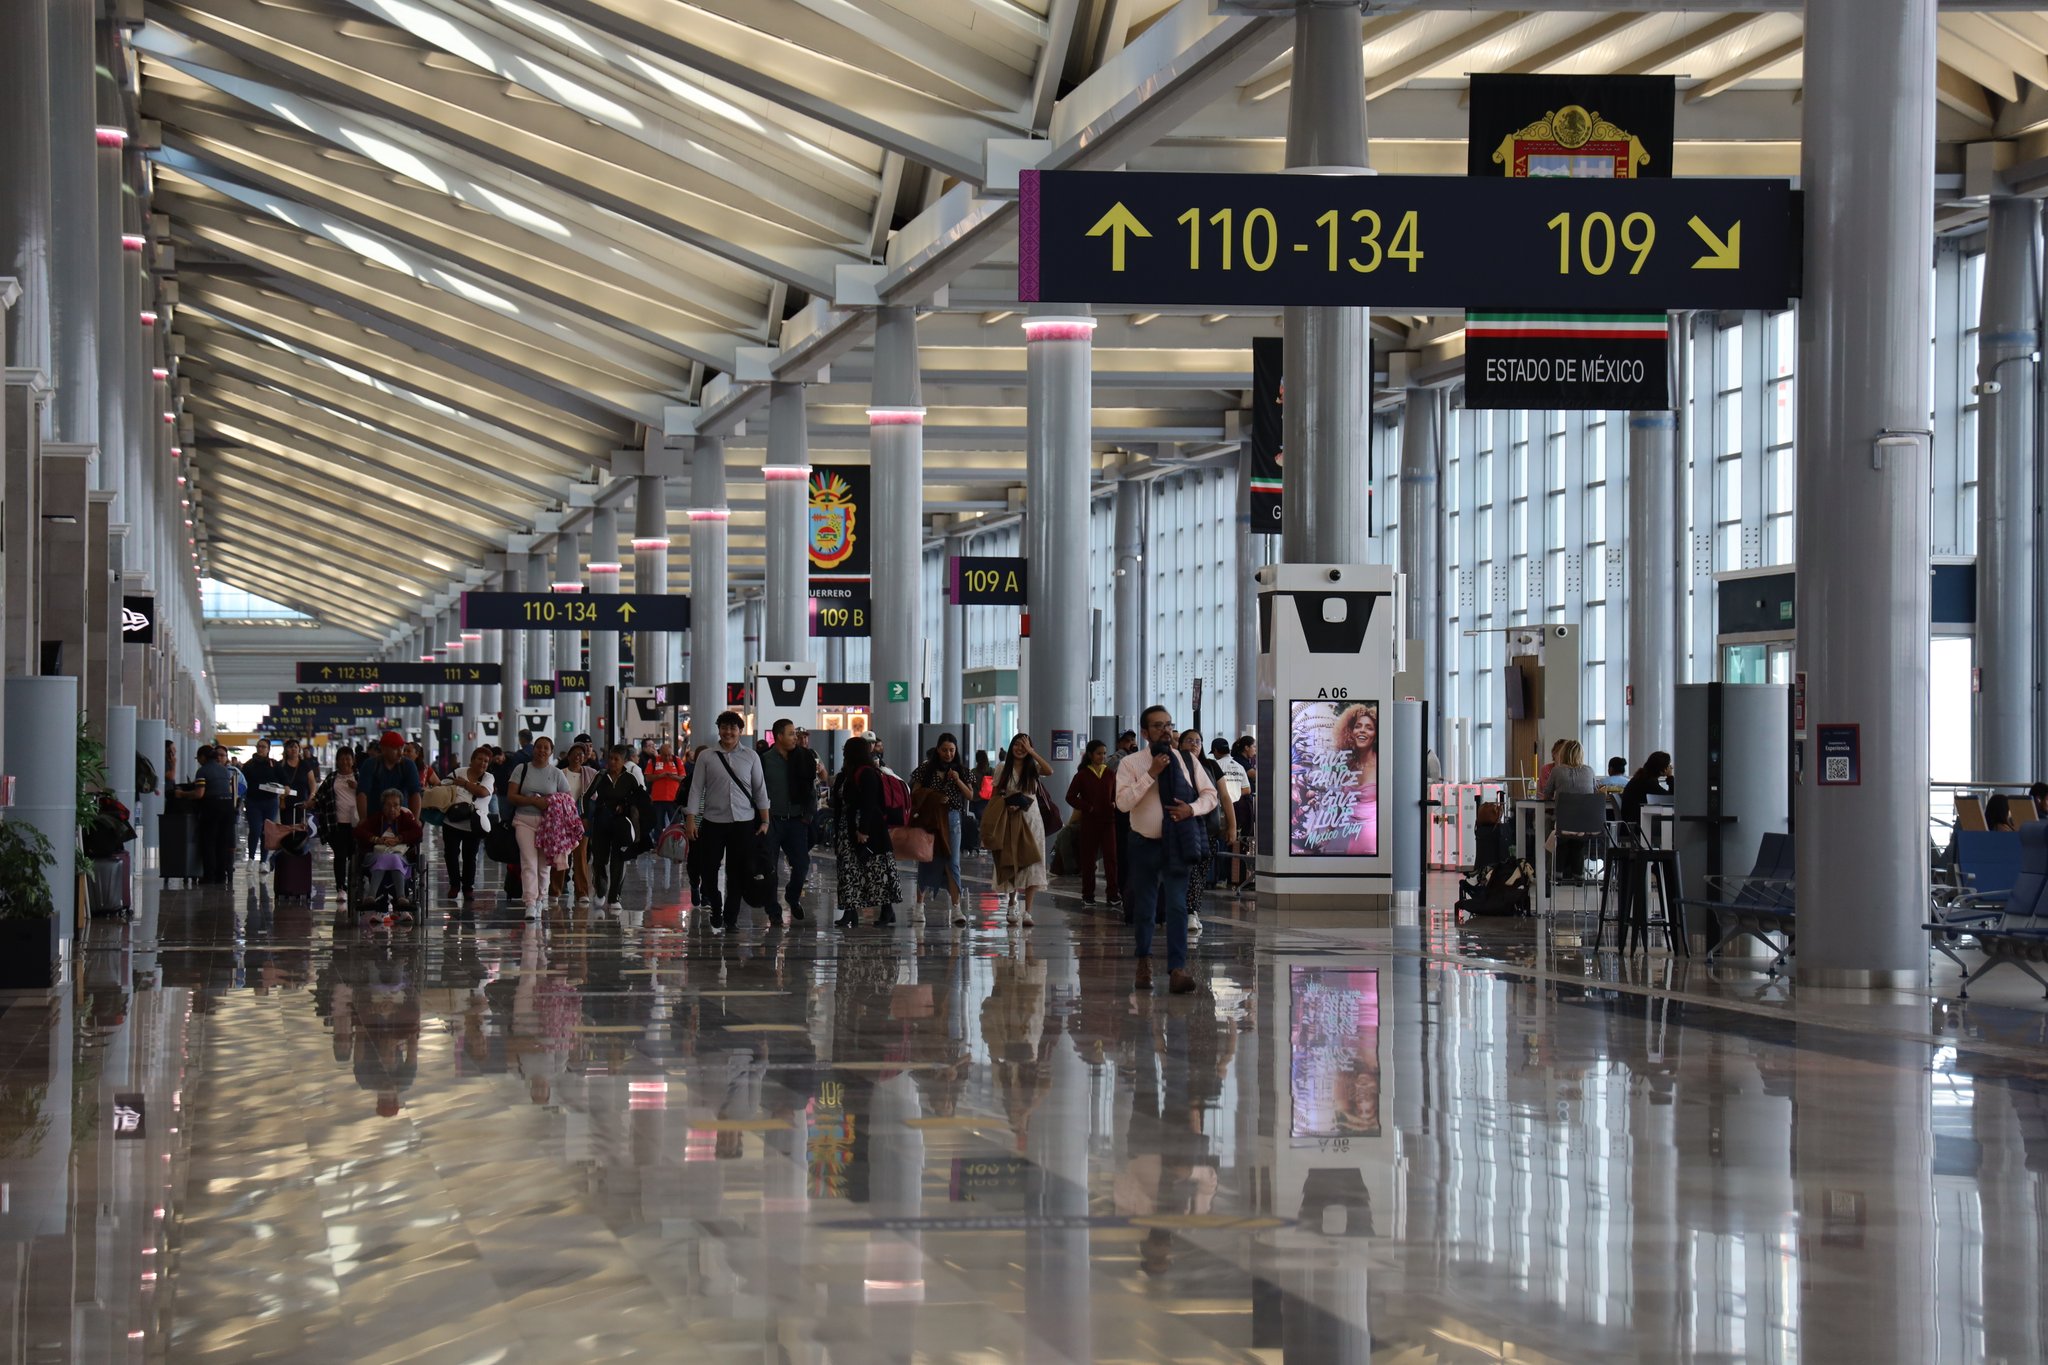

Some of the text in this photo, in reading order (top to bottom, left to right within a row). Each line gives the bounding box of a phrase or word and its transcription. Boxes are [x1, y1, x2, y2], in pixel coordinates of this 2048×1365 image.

[1546, 210, 1657, 277] 109
[1486, 354, 1644, 383] ESTADO DE MÉXICO
[964, 569, 1019, 593] 109 A
[809, 589, 851, 598] UERRERO
[820, 608, 864, 627] 109 B
[445, 668, 461, 680] 111
[561, 676, 585, 687] 110 A
[529, 685, 551, 695] 110 B
[1317, 687, 1348, 699] A 06
[1311, 769, 1362, 788] DANCE
